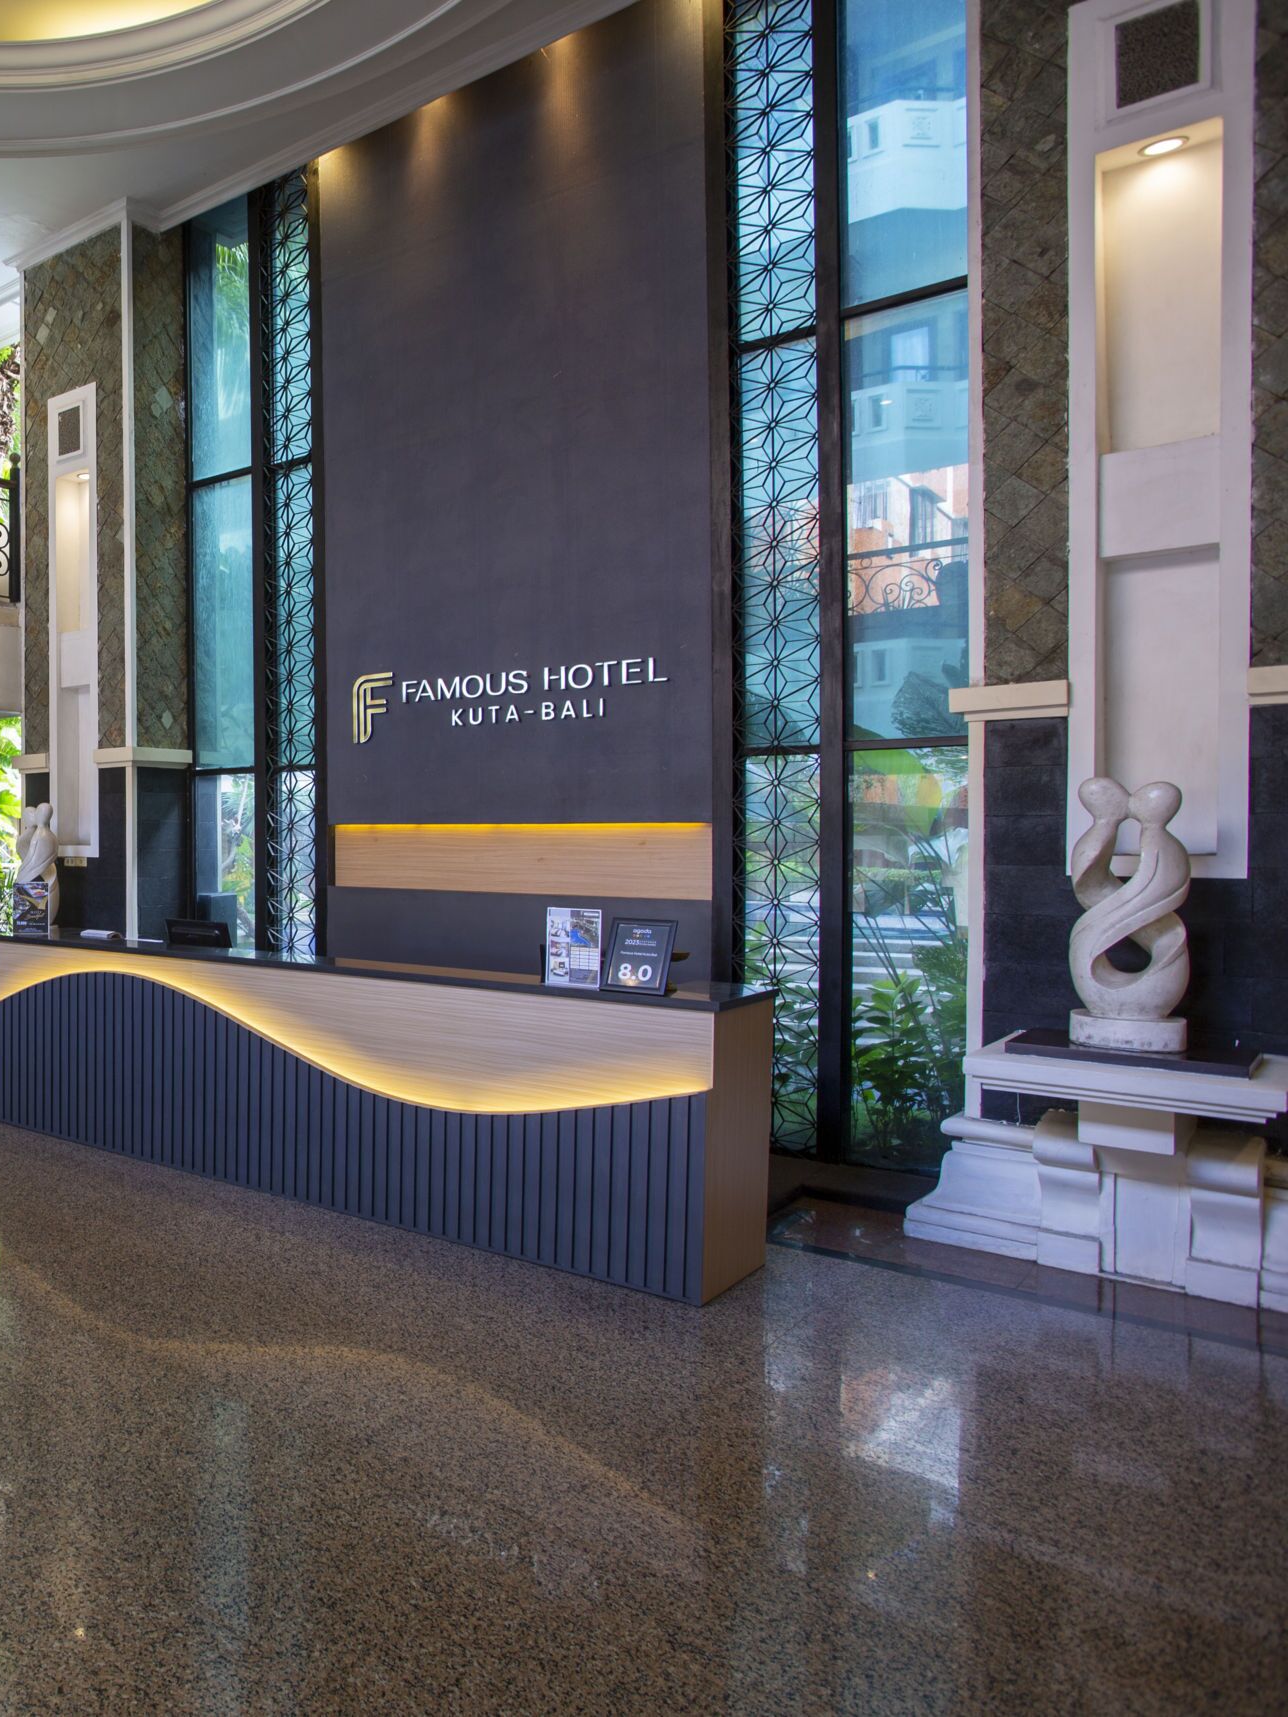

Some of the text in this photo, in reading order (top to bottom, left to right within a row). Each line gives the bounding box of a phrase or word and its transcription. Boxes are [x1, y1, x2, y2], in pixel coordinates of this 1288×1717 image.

[402, 657, 669, 704] FAMOUS HOTEL
[451, 697, 605, 727] KUTA-BALI
[632, 928, 652, 936] agoda
[617, 963, 653, 982] 8.0
